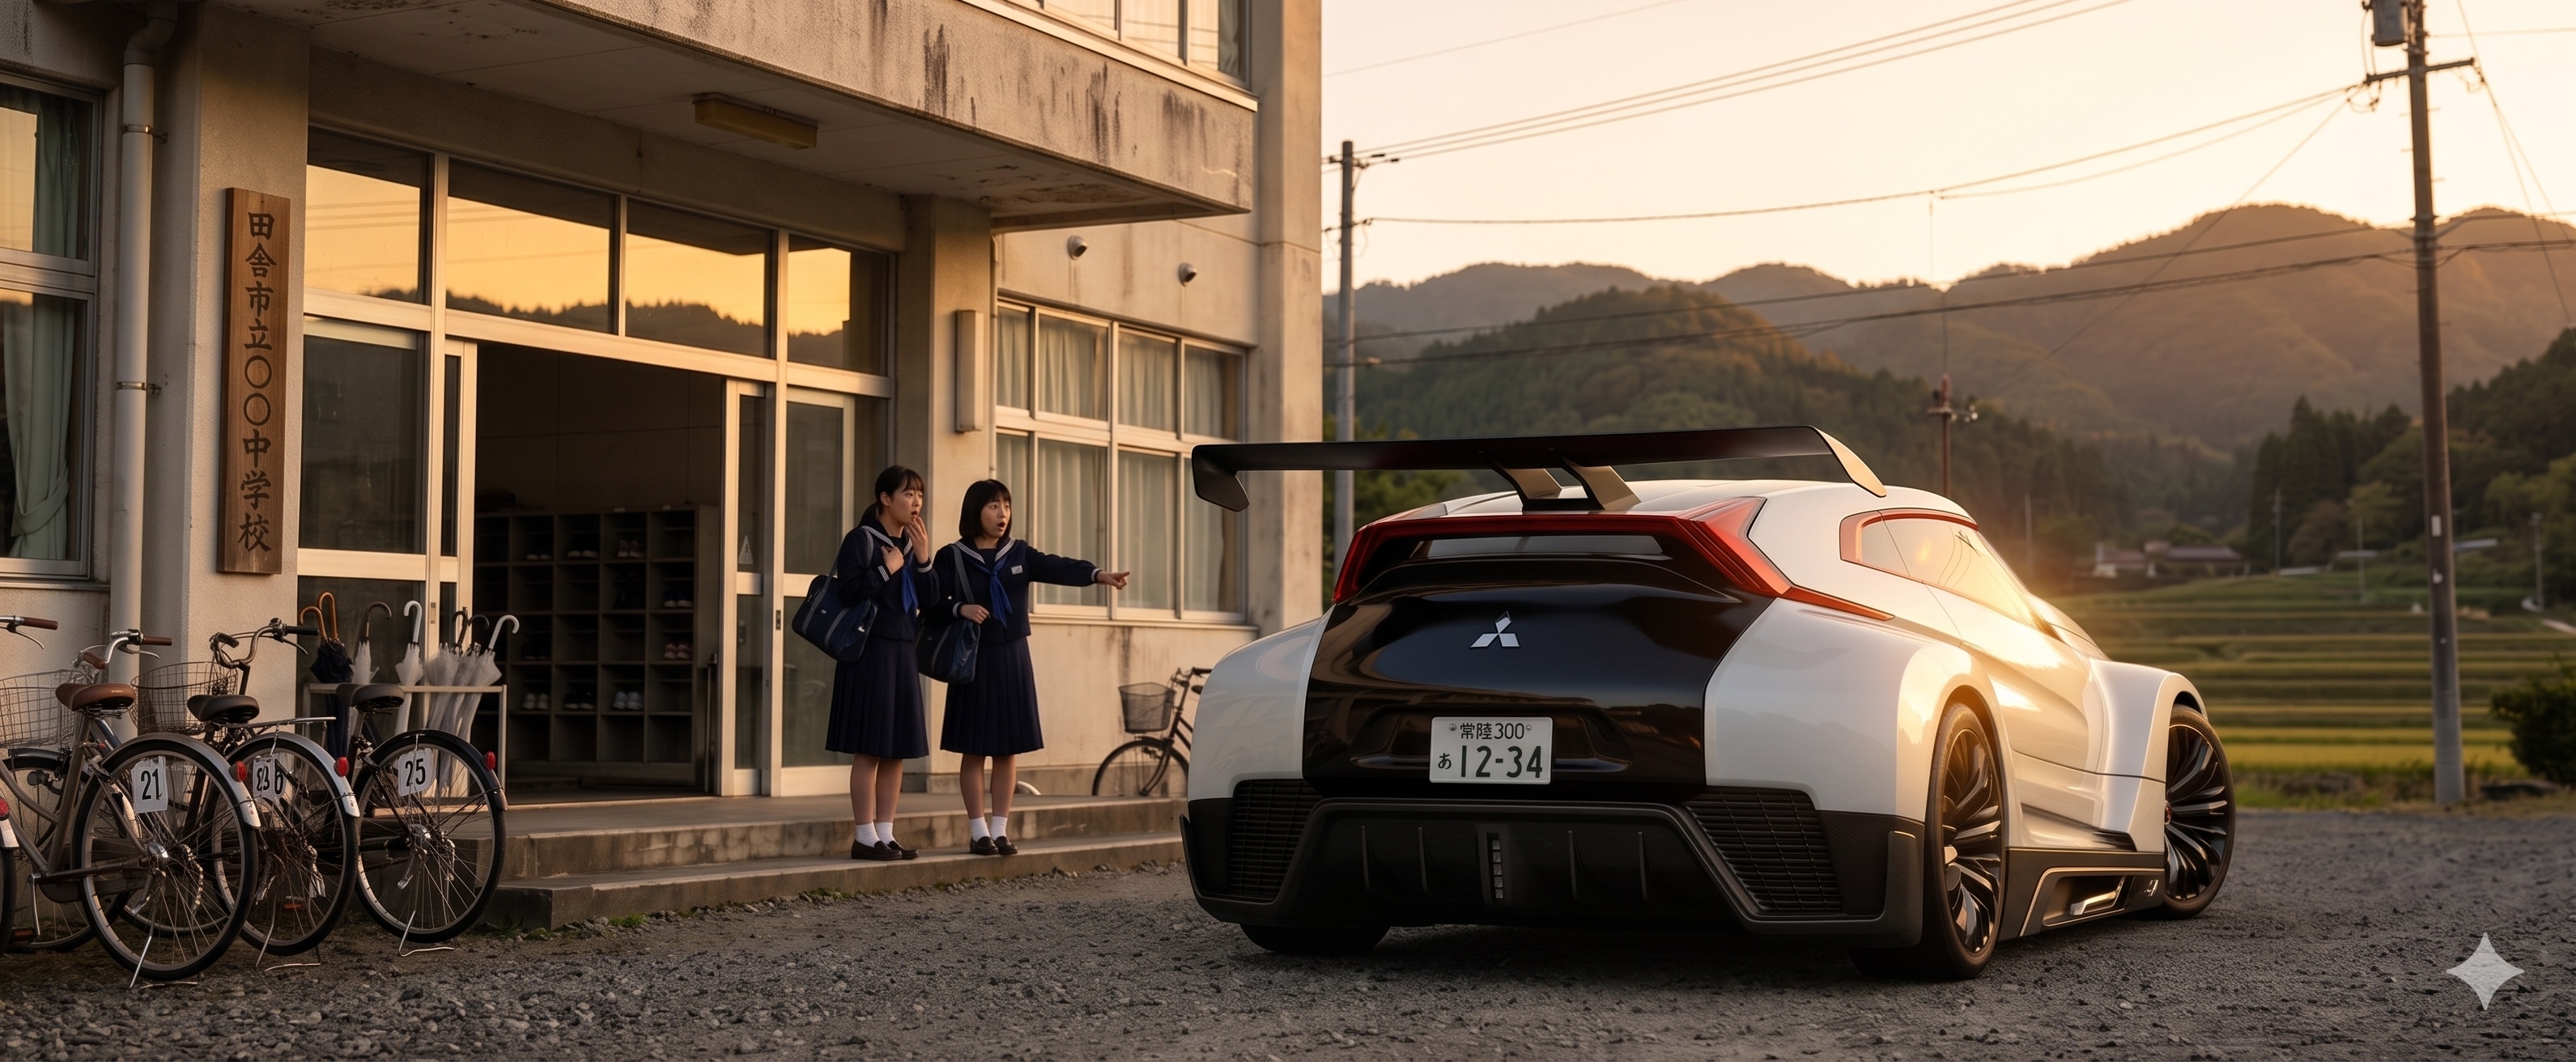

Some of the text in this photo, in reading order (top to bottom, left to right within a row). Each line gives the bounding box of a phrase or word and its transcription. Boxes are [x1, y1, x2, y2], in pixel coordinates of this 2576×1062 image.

[405, 758, 426, 787] 25
[1438, 745, 1542, 779] あ 12-34
[140, 768, 161, 801] 21
